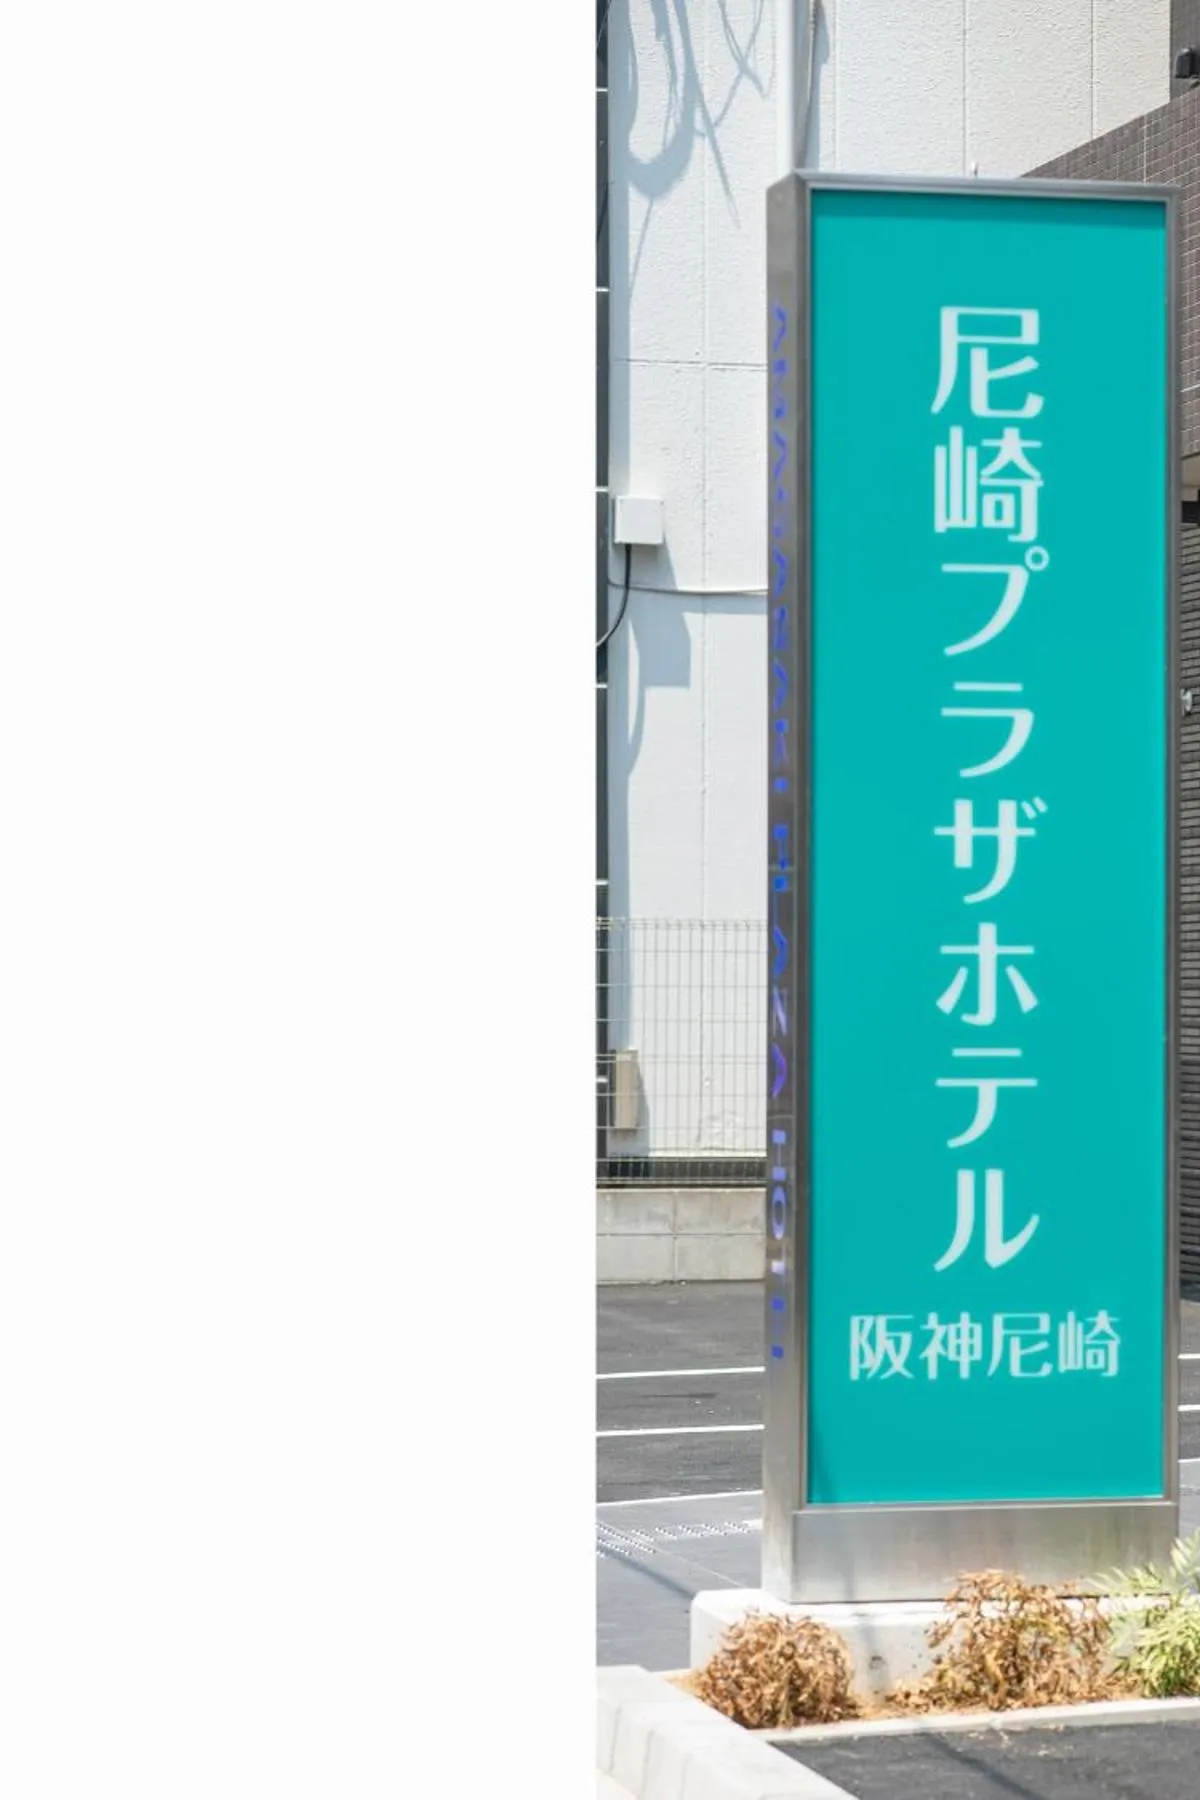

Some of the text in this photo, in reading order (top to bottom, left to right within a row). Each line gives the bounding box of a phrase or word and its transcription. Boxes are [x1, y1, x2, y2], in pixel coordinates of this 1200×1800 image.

[930, 306, 1049, 1272] 尼崎プラザホテル
[849, 1309, 1122, 1381] 阪神尼崎
